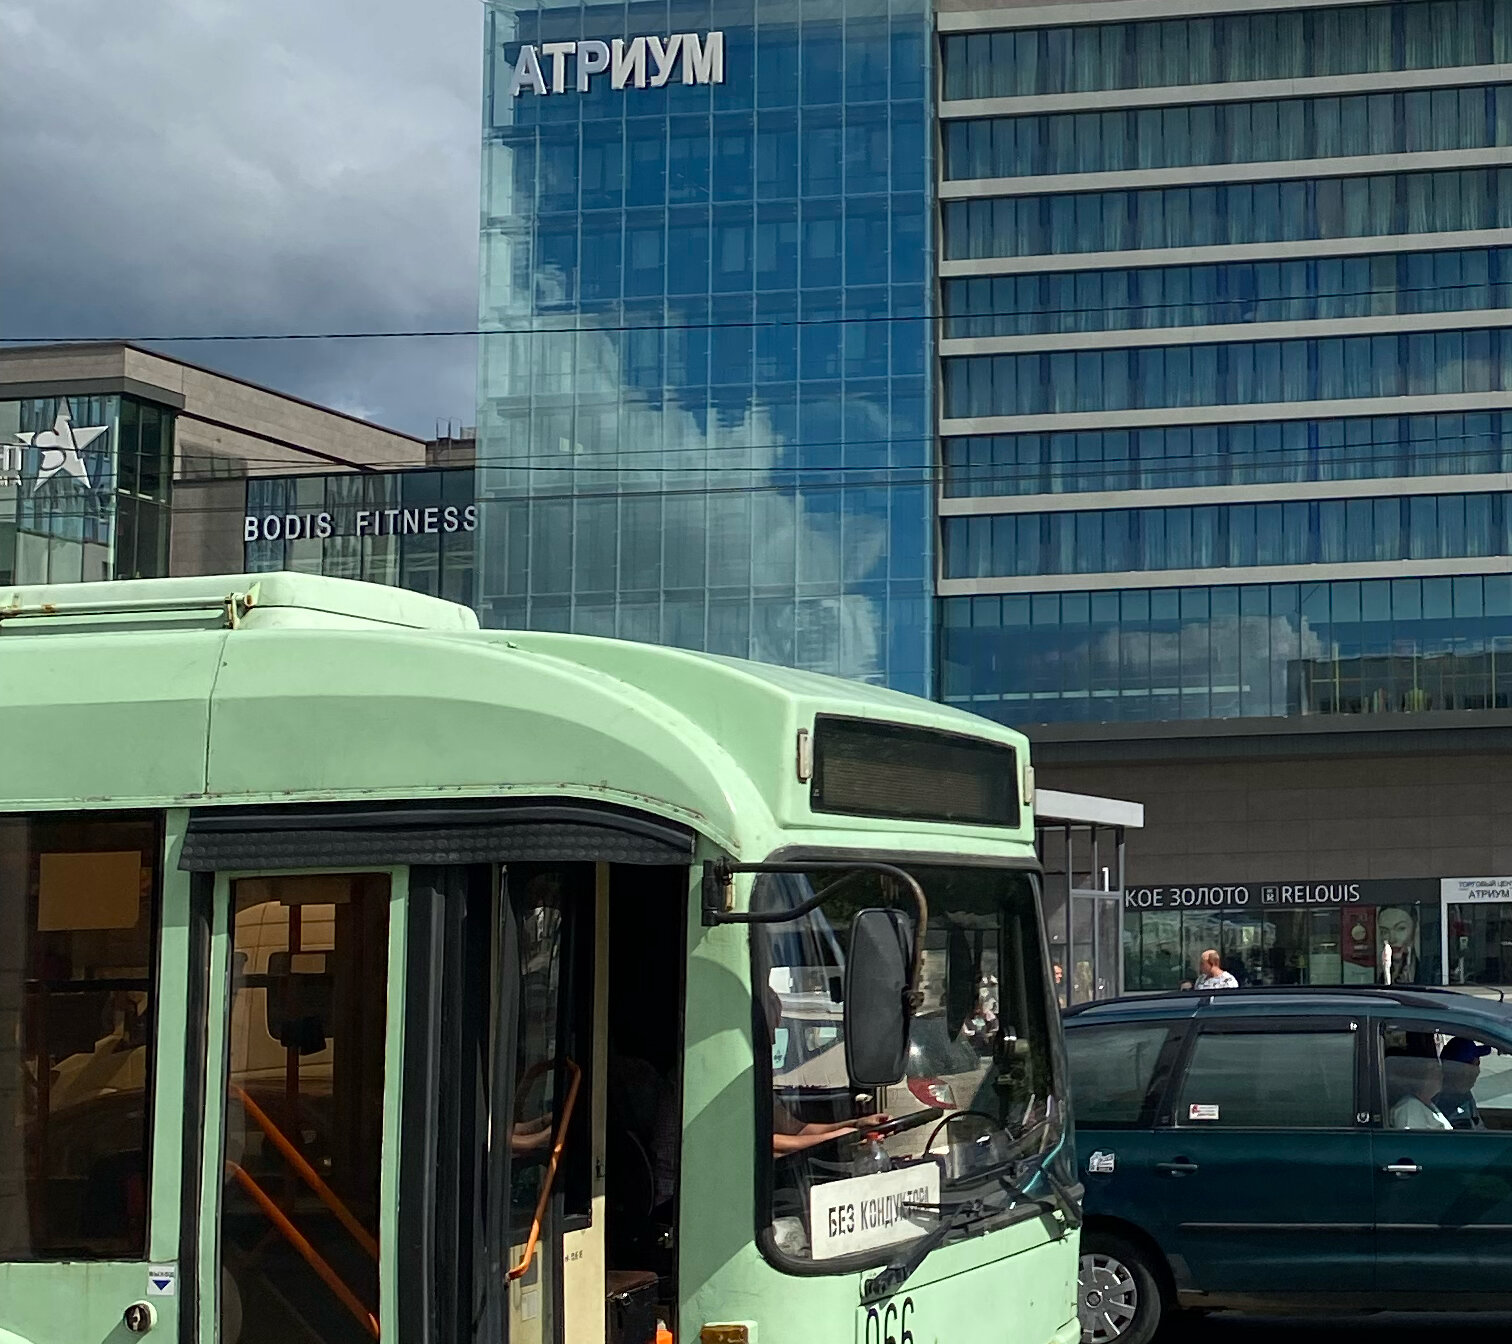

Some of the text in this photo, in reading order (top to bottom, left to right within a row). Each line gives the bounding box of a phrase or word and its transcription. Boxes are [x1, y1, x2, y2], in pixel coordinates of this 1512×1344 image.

[510, 31, 724, 96] АТРИУМ
[244, 506, 479, 542] BODIS FITNESS
[1169, 886, 1249, 906] ЗОЛОТО
[1281, 884, 1361, 903] RELOUIS
[1468, 889, 1510, 899] АТРИУМ
[828, 1203, 855, 1238] БЕЗ
